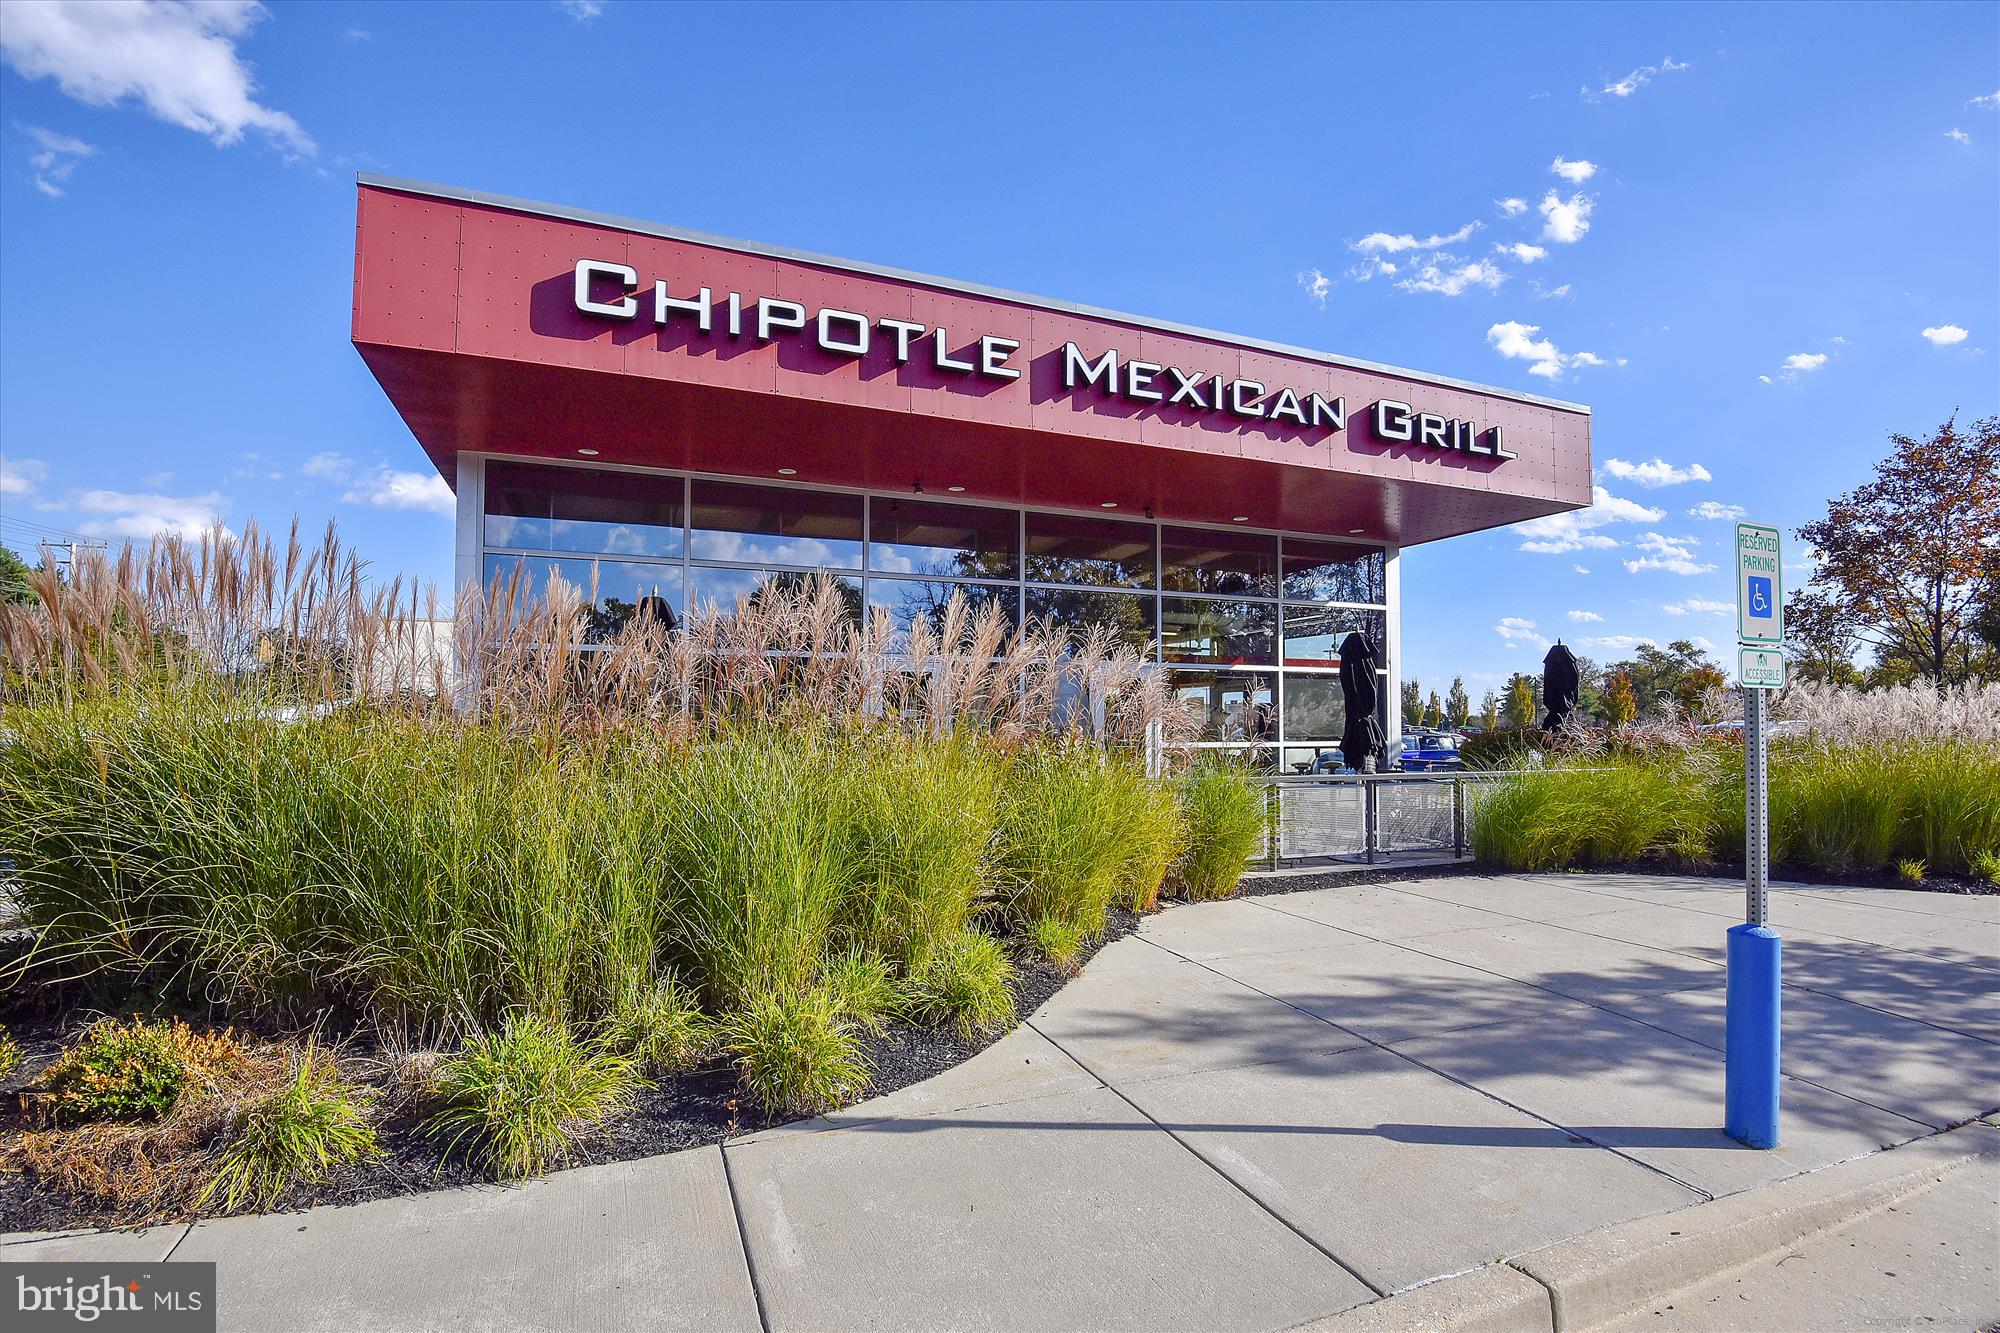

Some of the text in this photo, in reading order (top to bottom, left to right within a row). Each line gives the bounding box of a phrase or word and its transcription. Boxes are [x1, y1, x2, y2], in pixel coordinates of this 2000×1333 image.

[574, 258, 1519, 460] CHIPOTLE MEXICAN GRILL
[1740, 533, 1777, 553] RESERVED
[1743, 554, 1776, 573] PARKING
[1756, 655, 1768, 666] VAN
[1744, 668, 1780, 681] ACCESSIBLE
